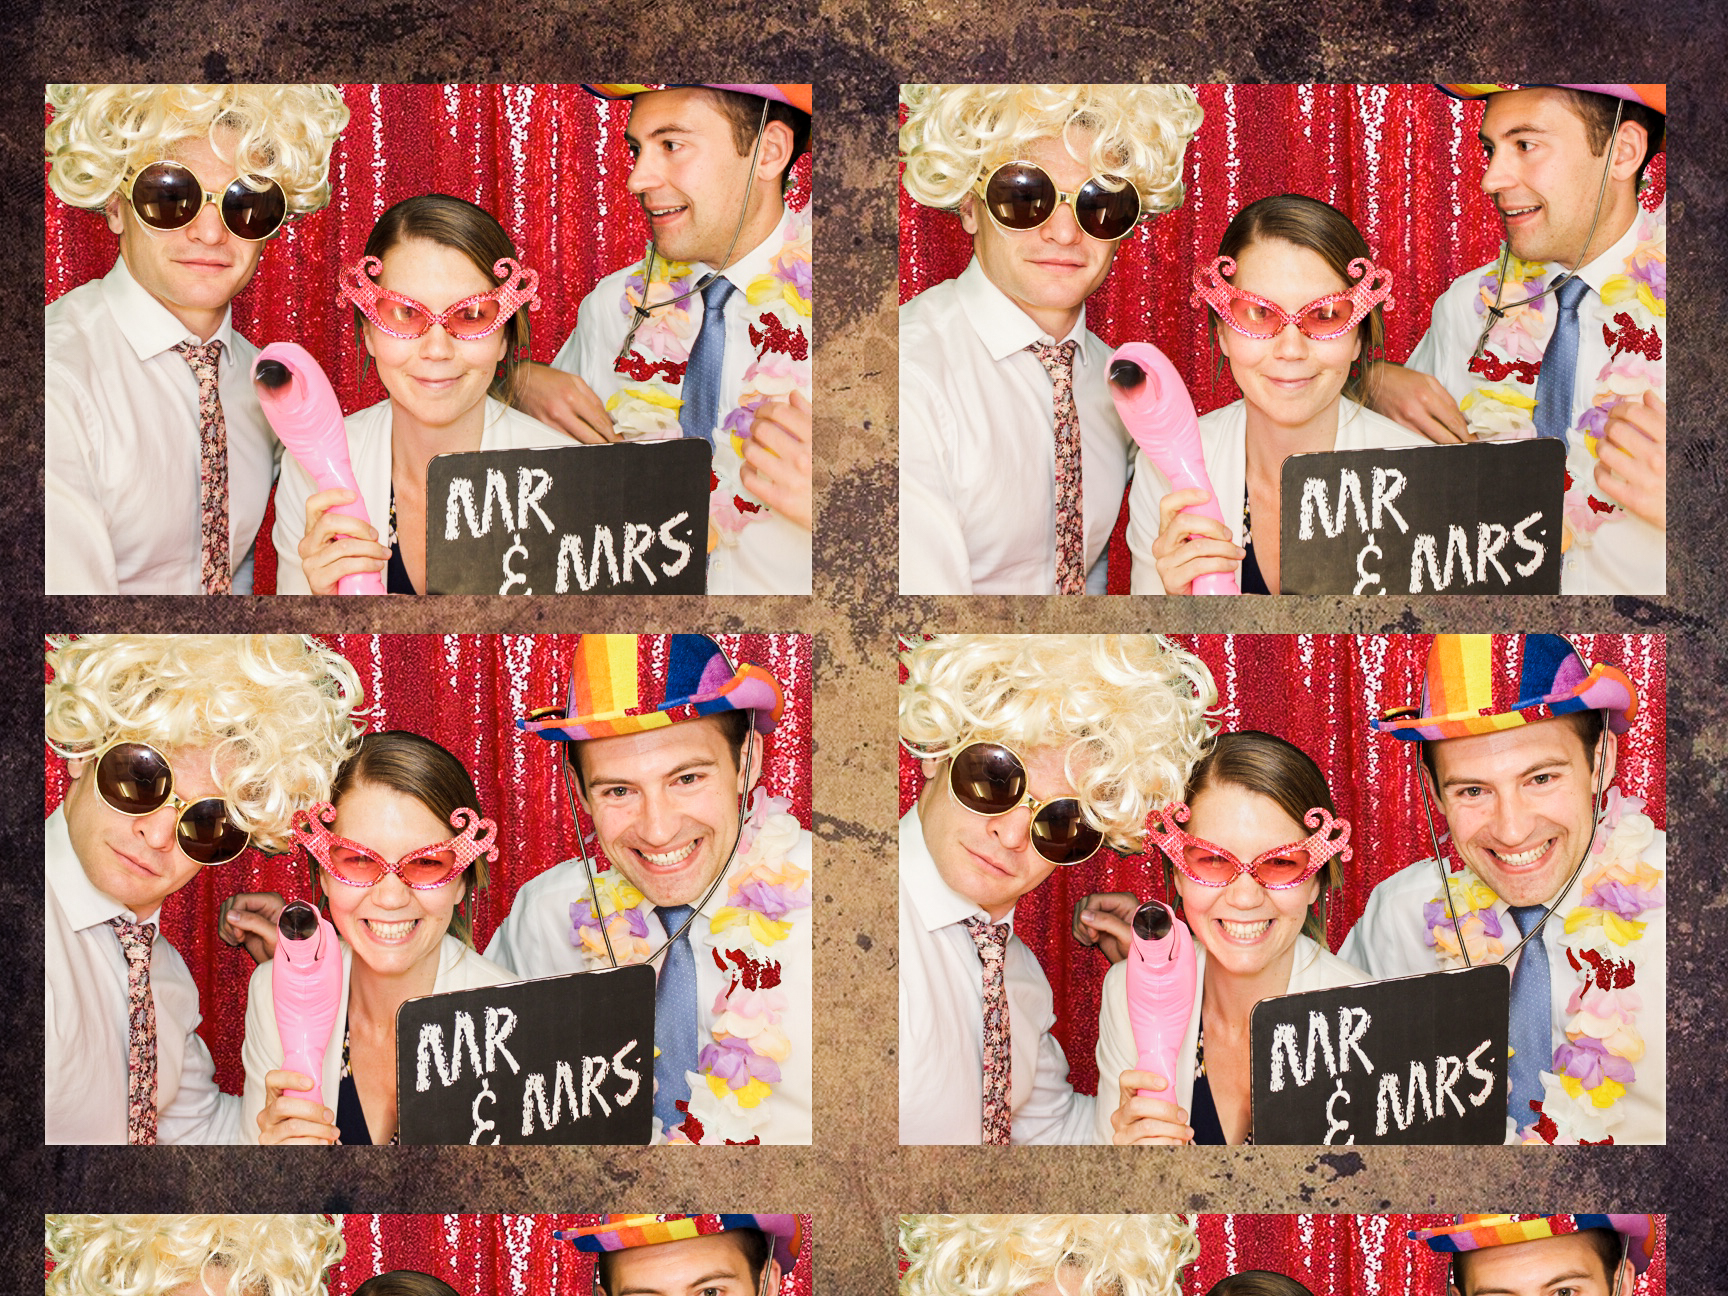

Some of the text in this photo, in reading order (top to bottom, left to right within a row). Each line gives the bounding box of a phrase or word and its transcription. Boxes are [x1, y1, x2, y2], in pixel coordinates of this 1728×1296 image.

[444, 466, 556, 541] MR
[1298, 466, 1410, 541] MR
[499, 511, 694, 595] & MRS
[1353, 511, 1548, 595] & MRS
[416, 1006, 520, 1092] MR
[1270, 1006, 1374, 1092] MR
[469, 1039, 642, 1145] & MRS
[1323, 1039, 1496, 1145] & MRS
